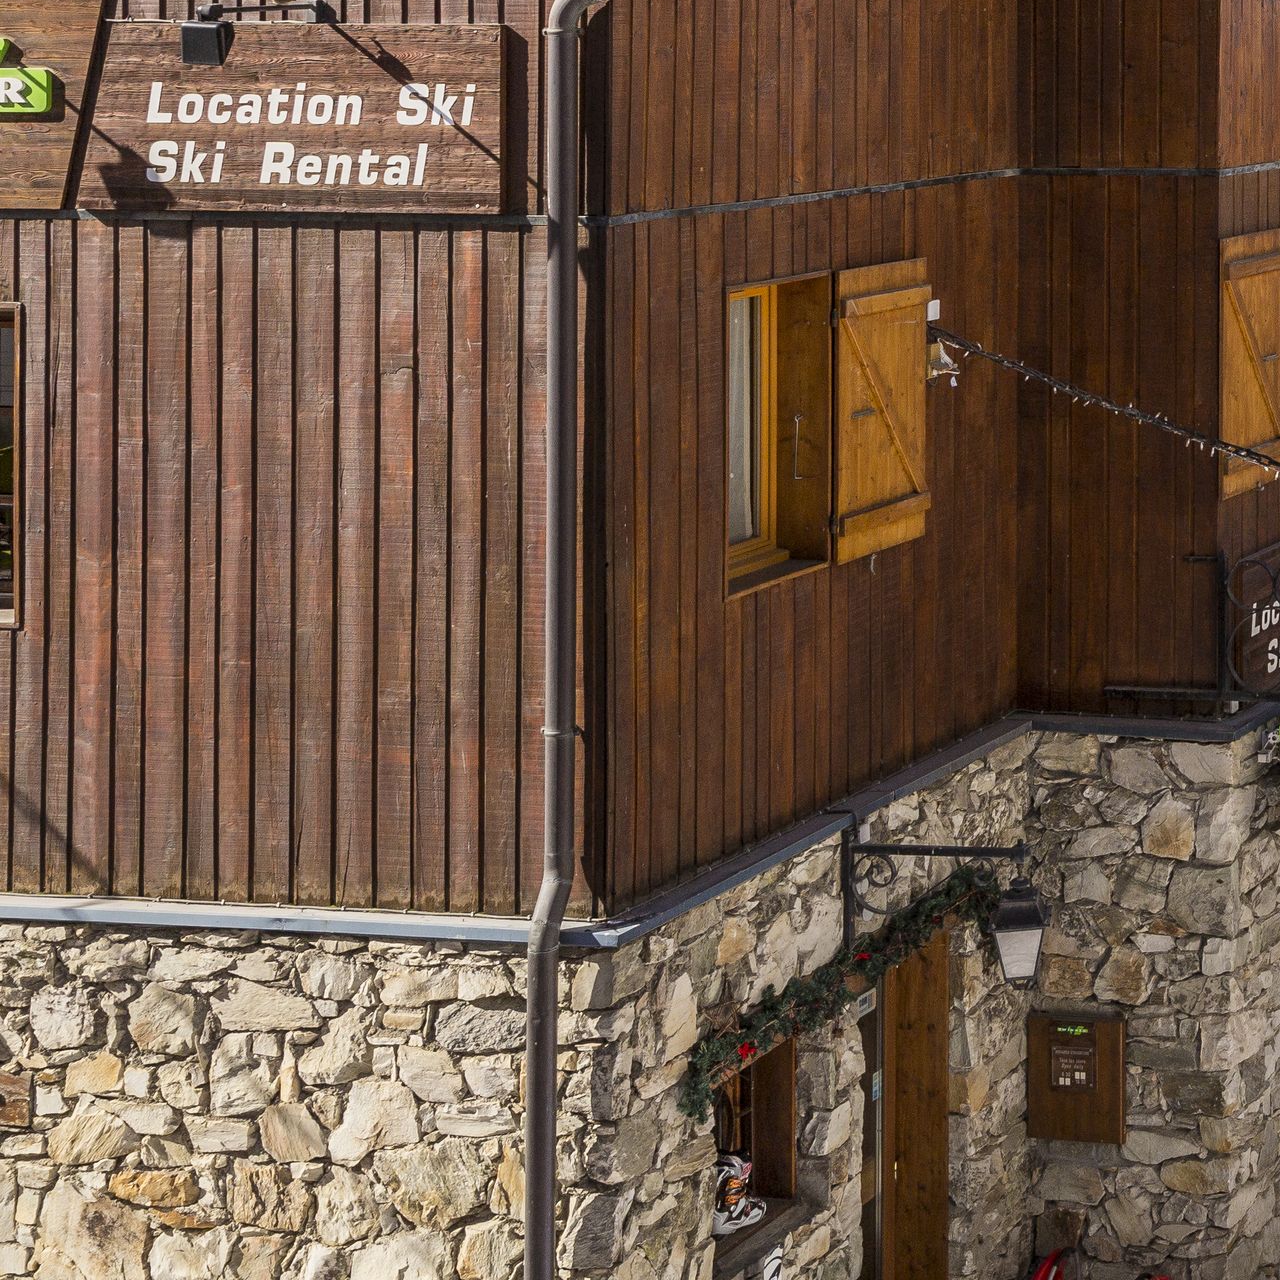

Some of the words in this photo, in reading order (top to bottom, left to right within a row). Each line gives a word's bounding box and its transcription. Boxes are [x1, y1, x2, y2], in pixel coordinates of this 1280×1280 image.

[146, 81, 363, 126] Location
[396, 82, 477, 127] Ski
[146, 140, 226, 184] Ski
[260, 141, 429, 187] Rental
